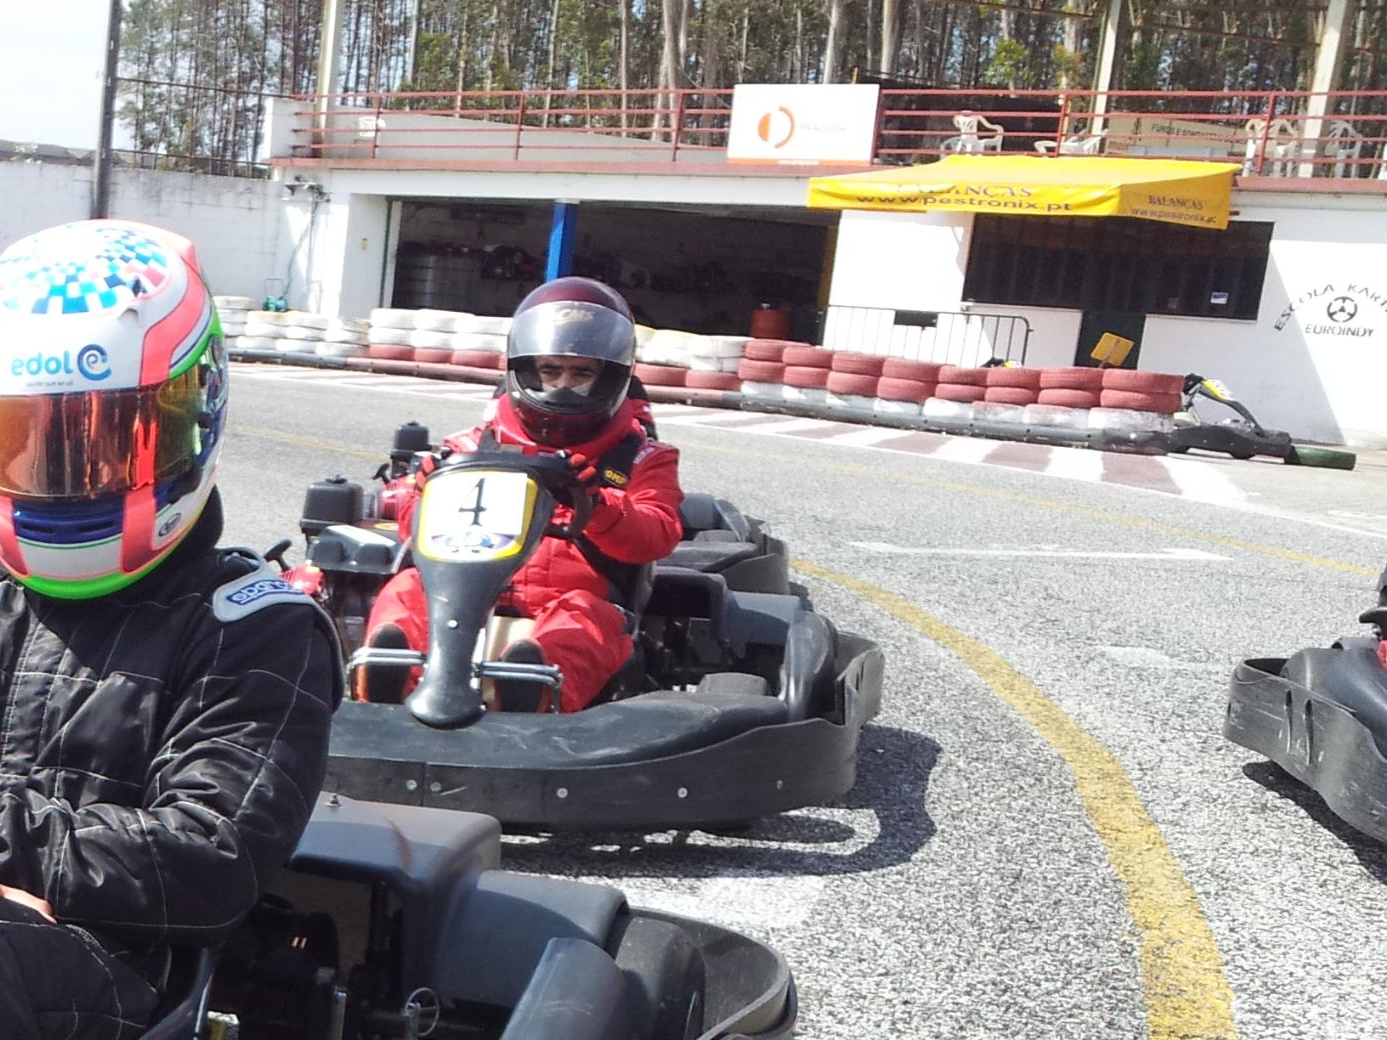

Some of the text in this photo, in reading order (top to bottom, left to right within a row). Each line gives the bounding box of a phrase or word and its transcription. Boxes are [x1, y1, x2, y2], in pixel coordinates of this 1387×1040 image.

[897, 184, 1032, 198] ANÇAS
[1347, 283, 1387, 313] KART
[1305, 323, 1375, 337] EUROINDY
[11, 350, 74, 376] edol
[458, 476, 488, 527] 4
